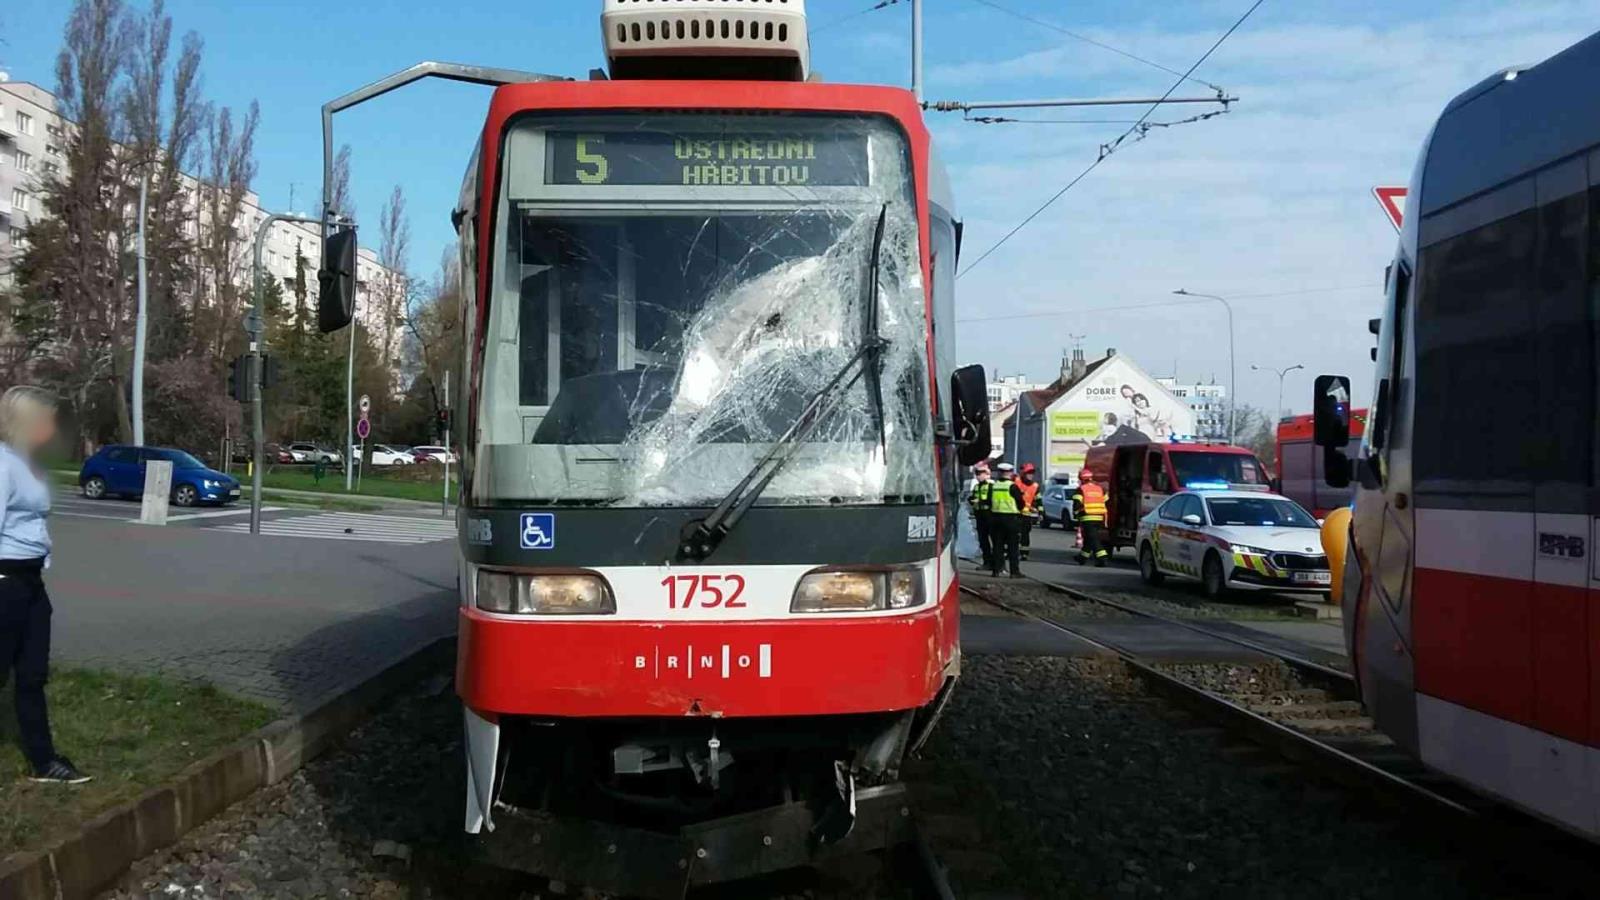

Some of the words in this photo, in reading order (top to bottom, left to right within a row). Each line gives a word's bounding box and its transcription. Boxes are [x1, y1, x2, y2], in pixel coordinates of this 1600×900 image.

[575, 135, 608, 185] 5
[1086, 387, 1117, 395] DOBRE
[660, 574, 747, 609] 1752
